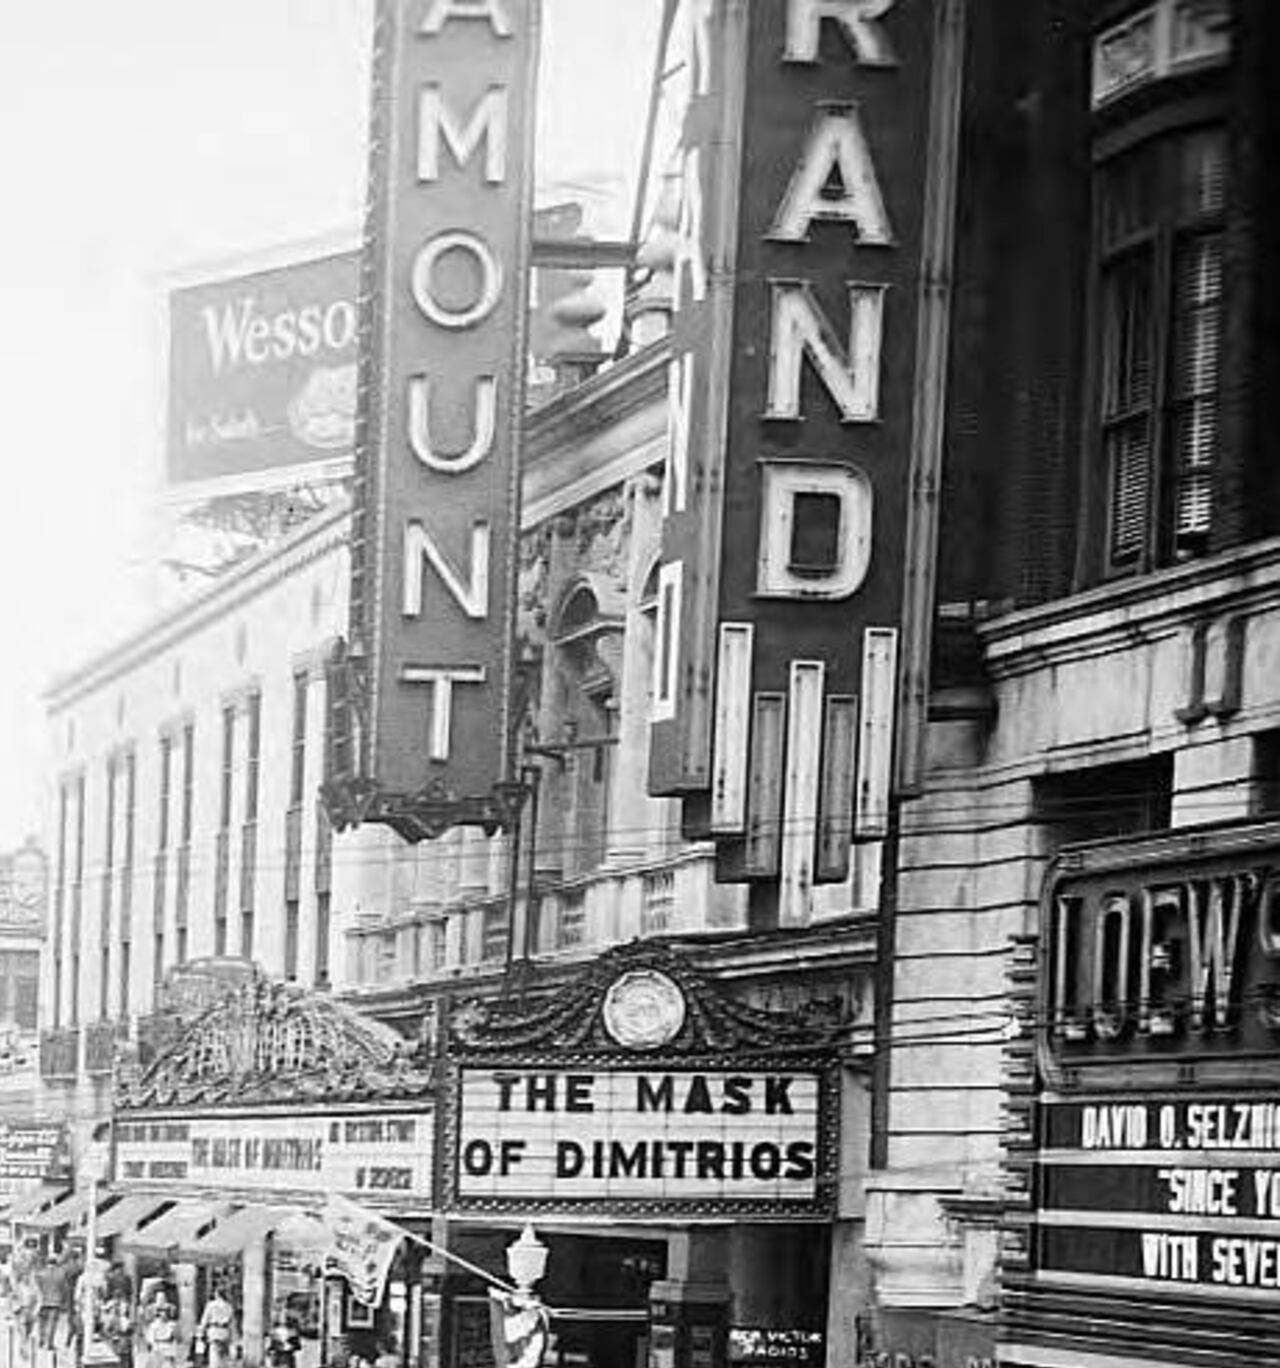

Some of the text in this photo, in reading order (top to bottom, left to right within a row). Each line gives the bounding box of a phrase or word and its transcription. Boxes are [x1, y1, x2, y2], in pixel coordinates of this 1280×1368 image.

[202, 297, 357, 374] Wesso
[493, 1073, 795, 1115] THE MASK
[1081, 1104, 1148, 1149] DAVID
[464, 1138, 814, 1179] OF DIMITRIOS
[1141, 1233, 1280, 1288] WITH SEVE
